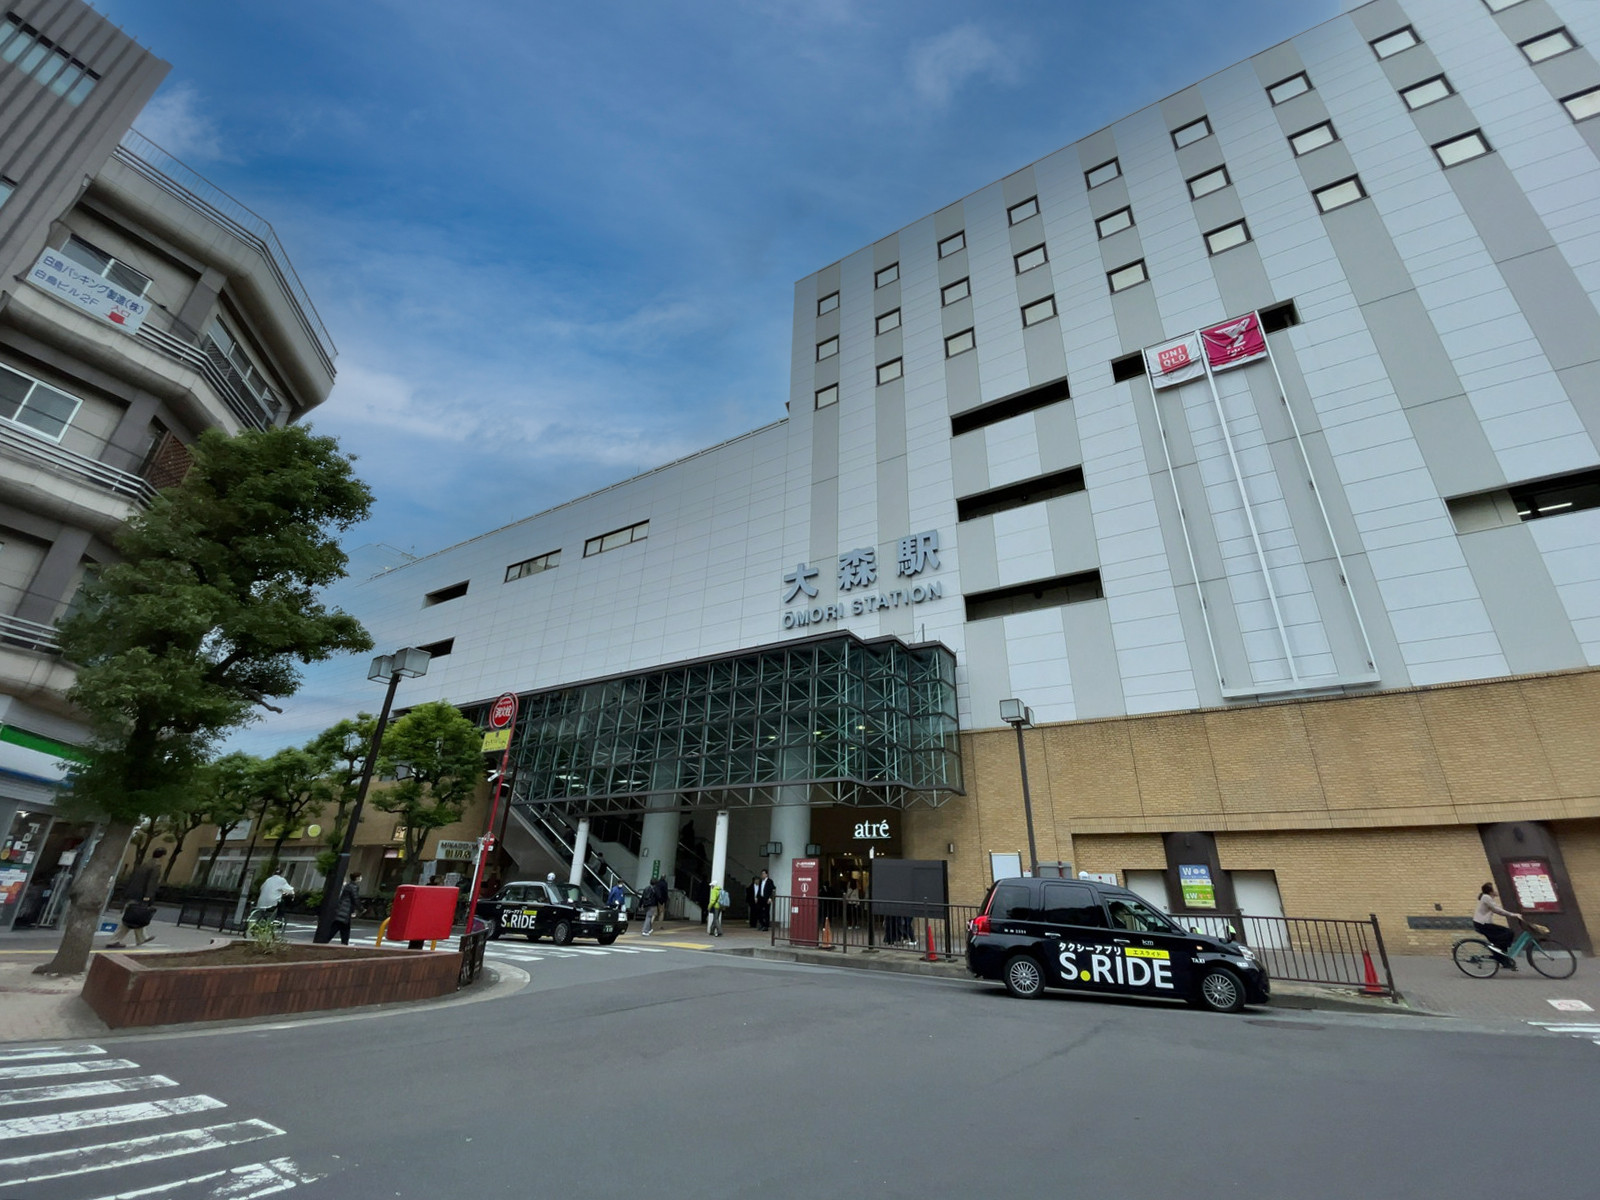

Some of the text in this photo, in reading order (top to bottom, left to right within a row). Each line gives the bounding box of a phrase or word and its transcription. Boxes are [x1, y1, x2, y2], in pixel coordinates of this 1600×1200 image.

[110, 305, 131, 318] 入口
[1161, 346, 1183, 360] UNI
[1163, 354, 1187, 367] QLO
[782, 528, 941, 604] 大森駅
[851, 580, 943, 616] STATION
[854, 819, 890, 838] atré
[501, 914, 536, 930] S.RIDE
[1059, 942, 1122, 955] タクシーアプリ
[1058, 951, 1175, 990] S.RIDE
